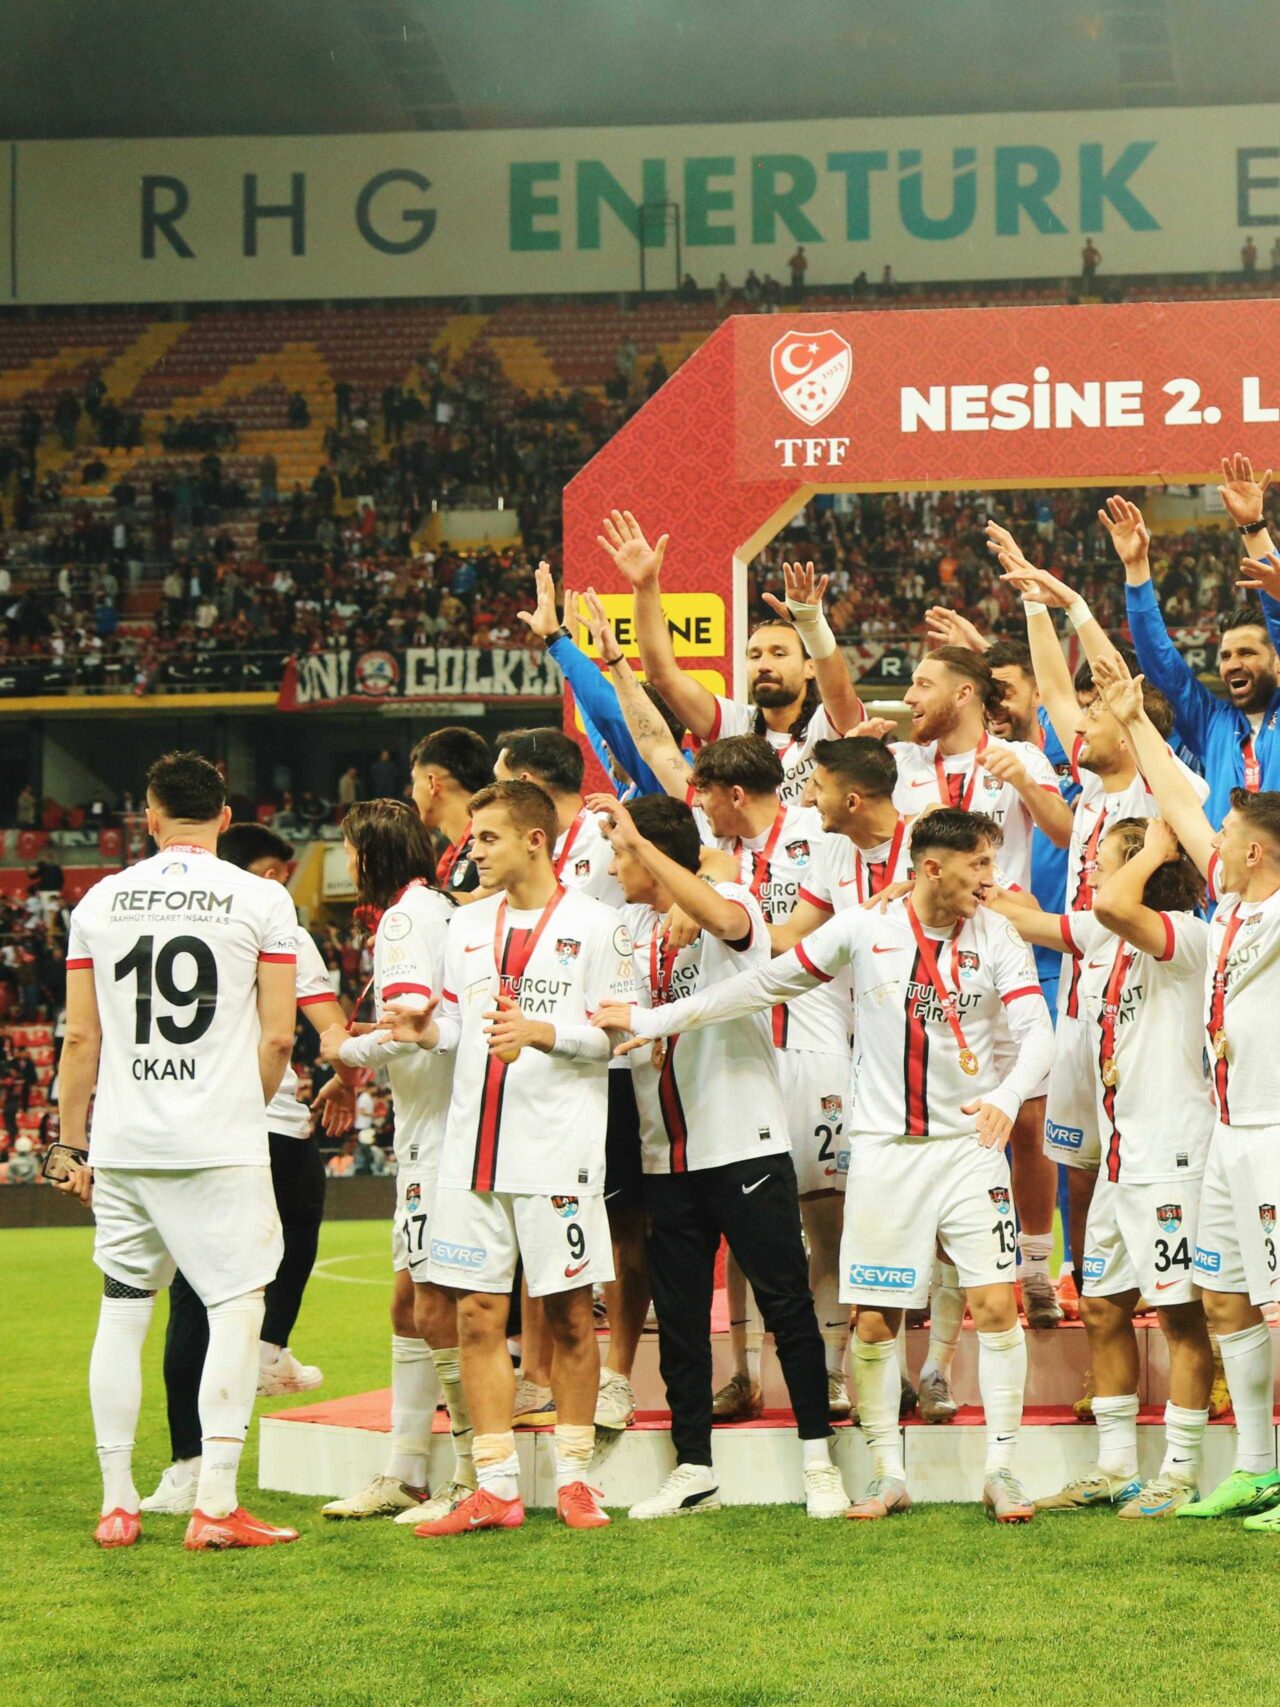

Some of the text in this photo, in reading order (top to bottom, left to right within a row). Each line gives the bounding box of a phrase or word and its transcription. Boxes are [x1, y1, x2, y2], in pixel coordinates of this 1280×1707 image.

[140, 168, 437, 260] RHG
[508, 140, 1162, 252] ENERTÜRK
[900, 366, 1144, 433] NESİNE
[1163, 377, 1221, 425] 2.
[774, 437, 850, 467] TFF
[111, 889, 234, 914] REFORM
[114, 934, 219, 1045] 19
[500, 975, 573, 997] TURGUT
[914, 1003, 967, 1023] FIRT
[132, 1058, 196, 1081] OKAN
[402, 1213, 428, 1254] 17
[566, 1222, 586, 1260] 9
[991, 1219, 1016, 1254] 13
[1154, 1236, 1193, 1273] 34
[1264, 1237, 1277, 1272] 3
